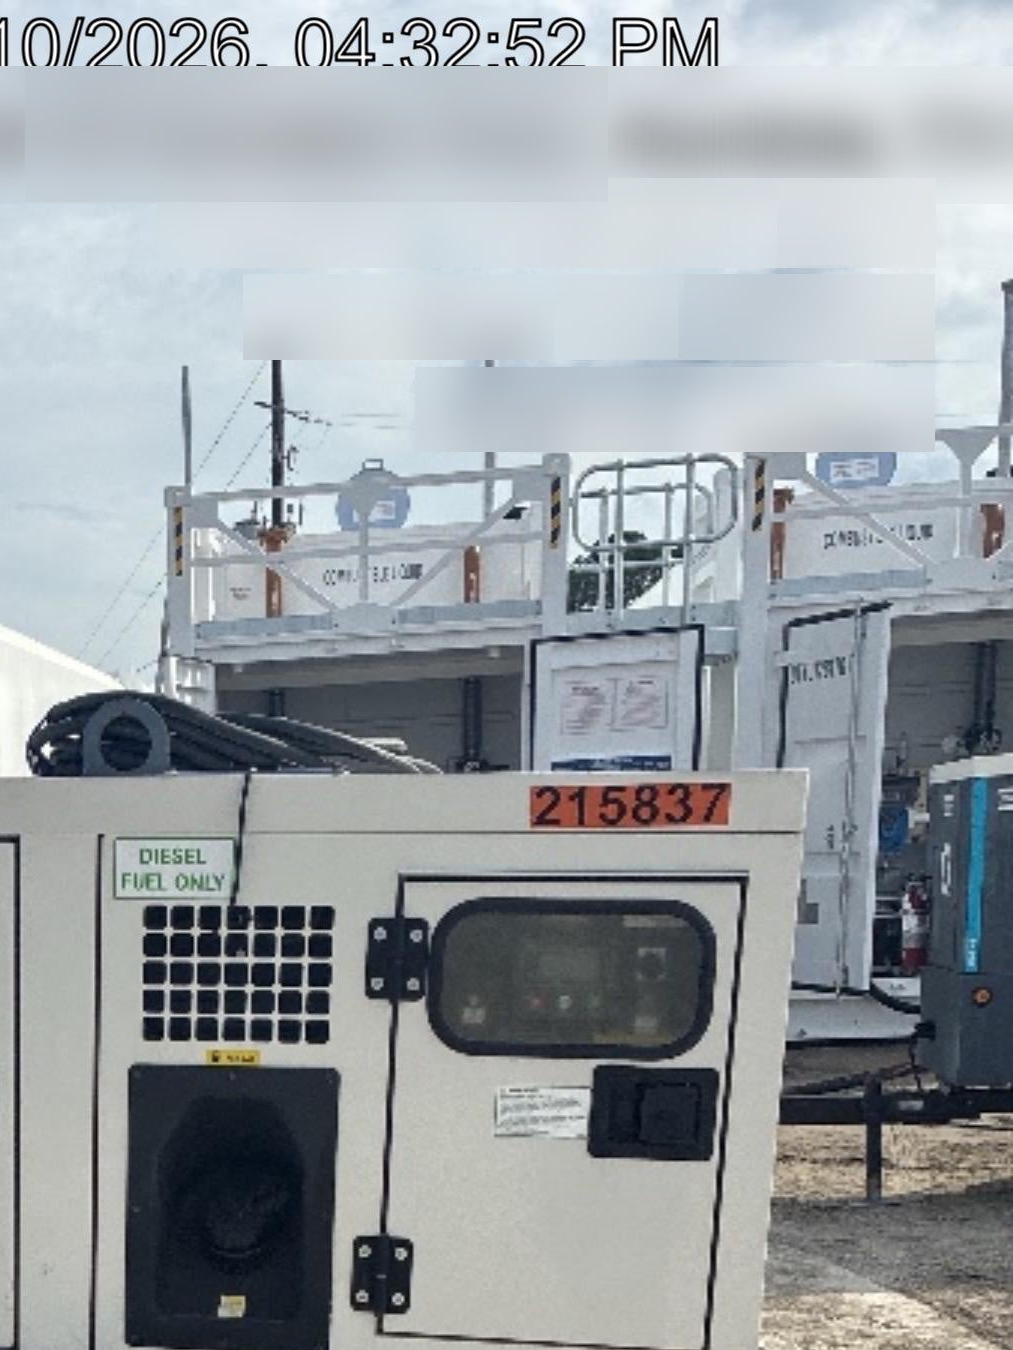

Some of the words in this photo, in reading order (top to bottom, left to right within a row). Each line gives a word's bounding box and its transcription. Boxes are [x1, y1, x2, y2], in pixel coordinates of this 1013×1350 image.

[532, 783, 728, 826] 215837
[139, 848, 206, 865] DIESEL
[121, 872, 167, 892] FUEL
[174, 872, 226, 892] ONLY
